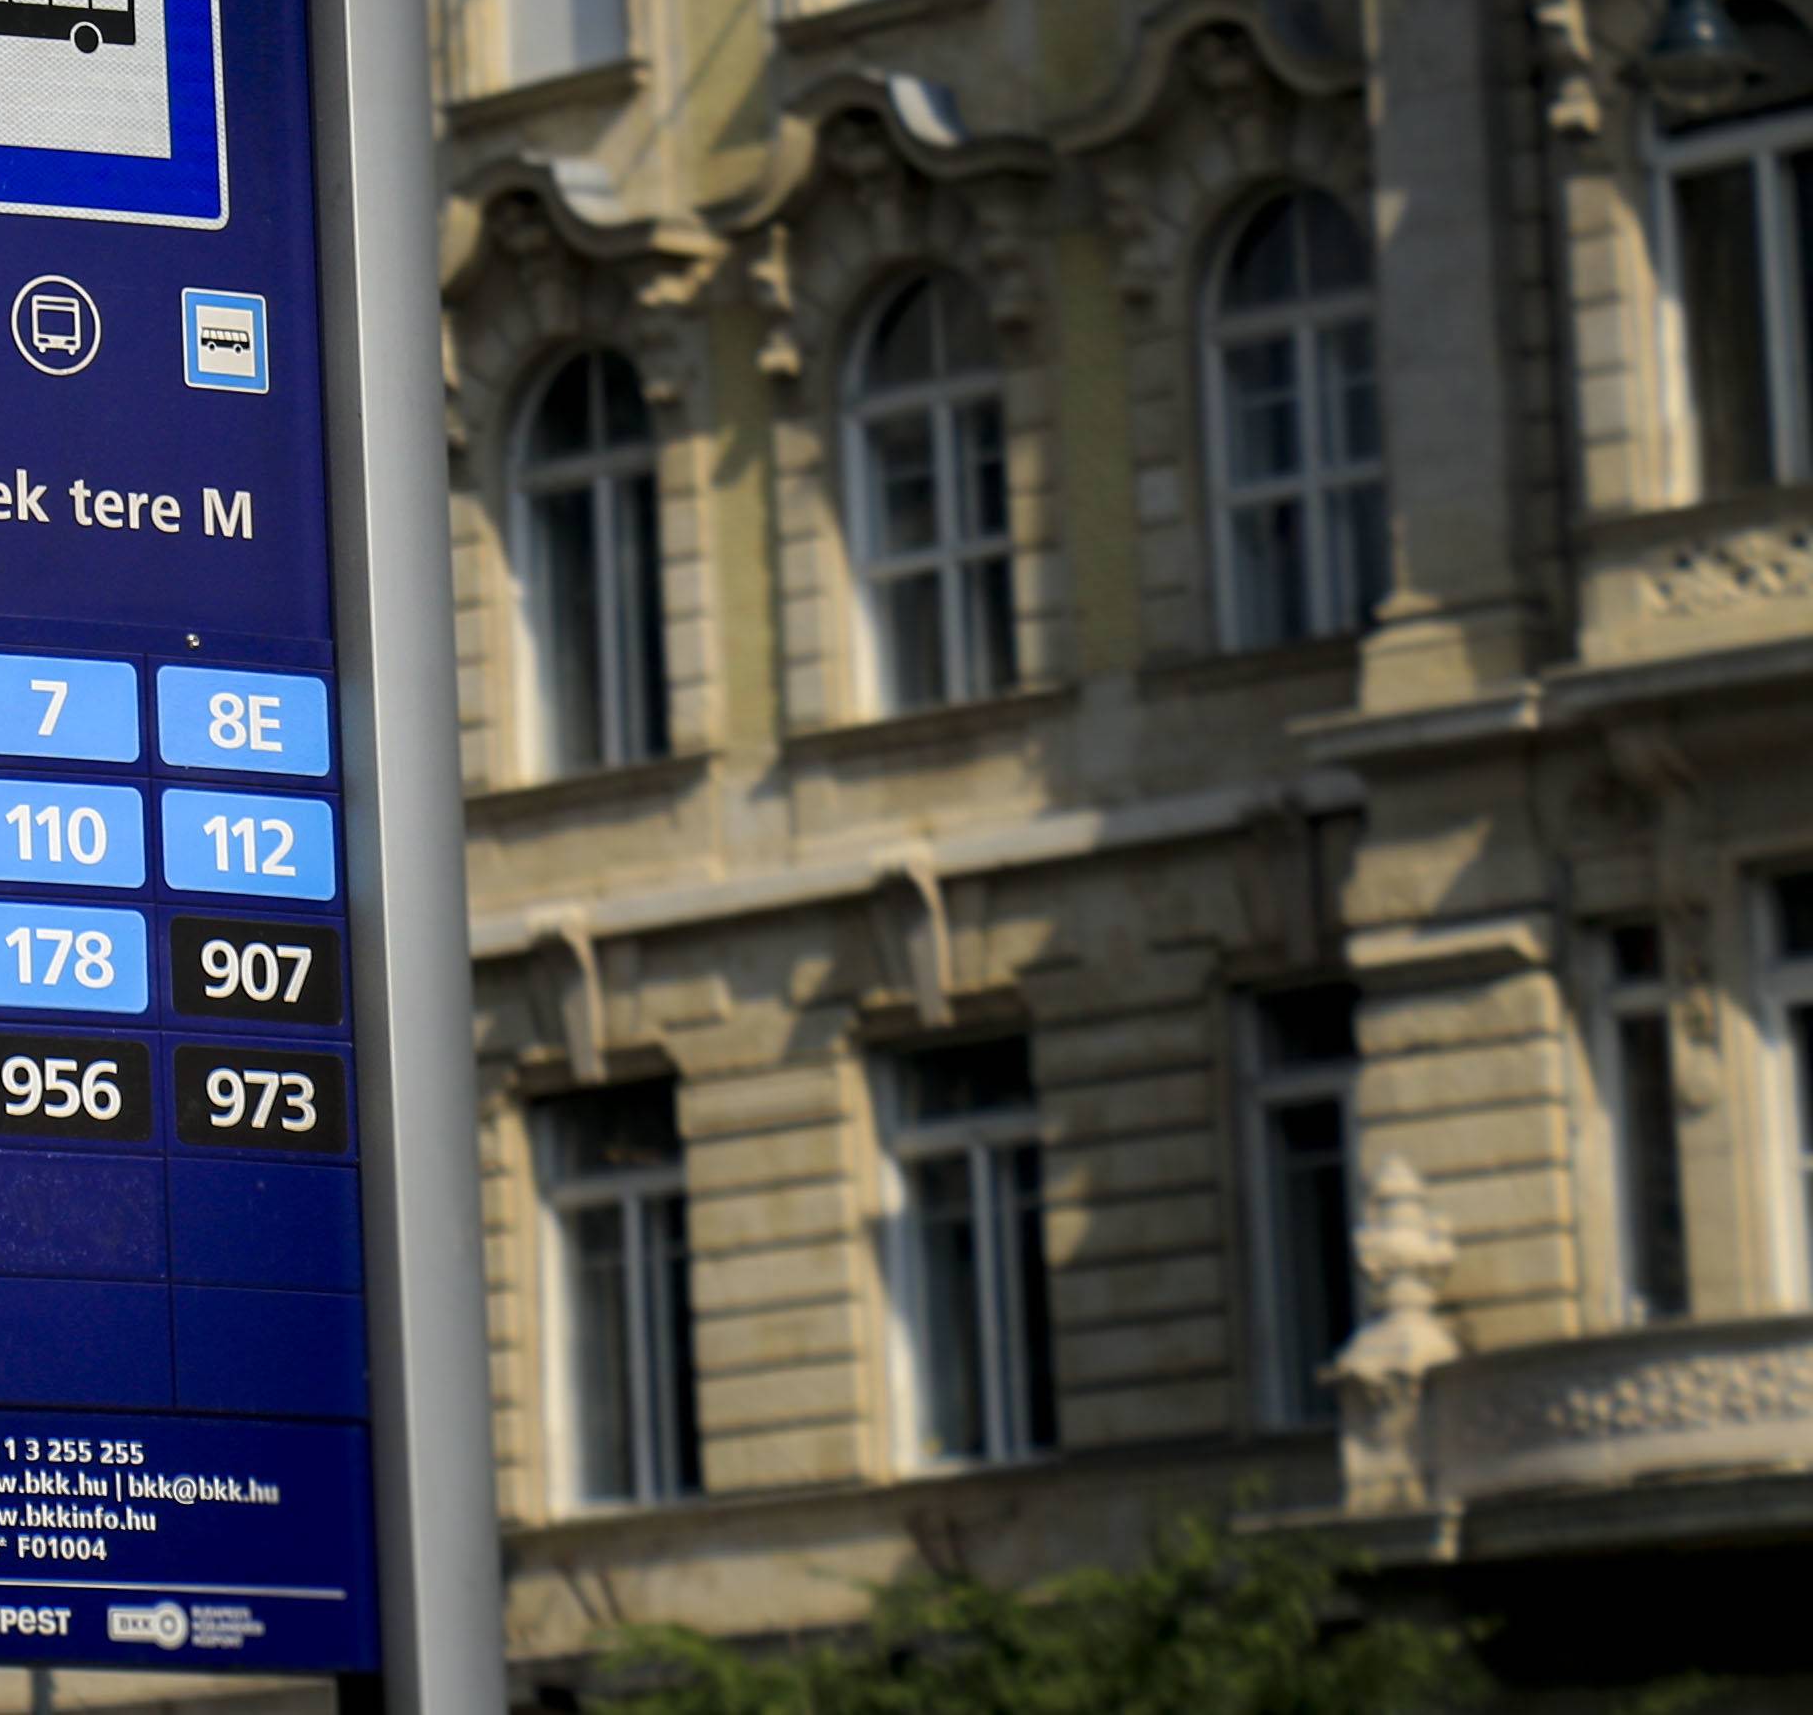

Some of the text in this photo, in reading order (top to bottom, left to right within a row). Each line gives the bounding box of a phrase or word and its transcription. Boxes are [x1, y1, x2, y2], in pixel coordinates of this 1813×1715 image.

[68, 478, 181, 533] tere
[202, 487, 253, 540] M
[30, 679, 68, 736] 7
[208, 692, 283, 752] 8E
[5, 804, 107, 864] 110
[203, 815, 296, 876] 112
[5, 927, 114, 988] 178
[201, 939, 312, 1003] 907
[1, 1056, 122, 1120] 956
[206, 1068, 317, 1132] 973
[4, 1437, 16, 1461] 1
[25, 1438, 40, 1461] 3
[47, 1439, 93, 1463] 255
[100, 1441, 145, 1465] 255
[127, 1472, 280, 1505] bkk@bkk.hu
[17, 1536, 108, 1561] F01004
